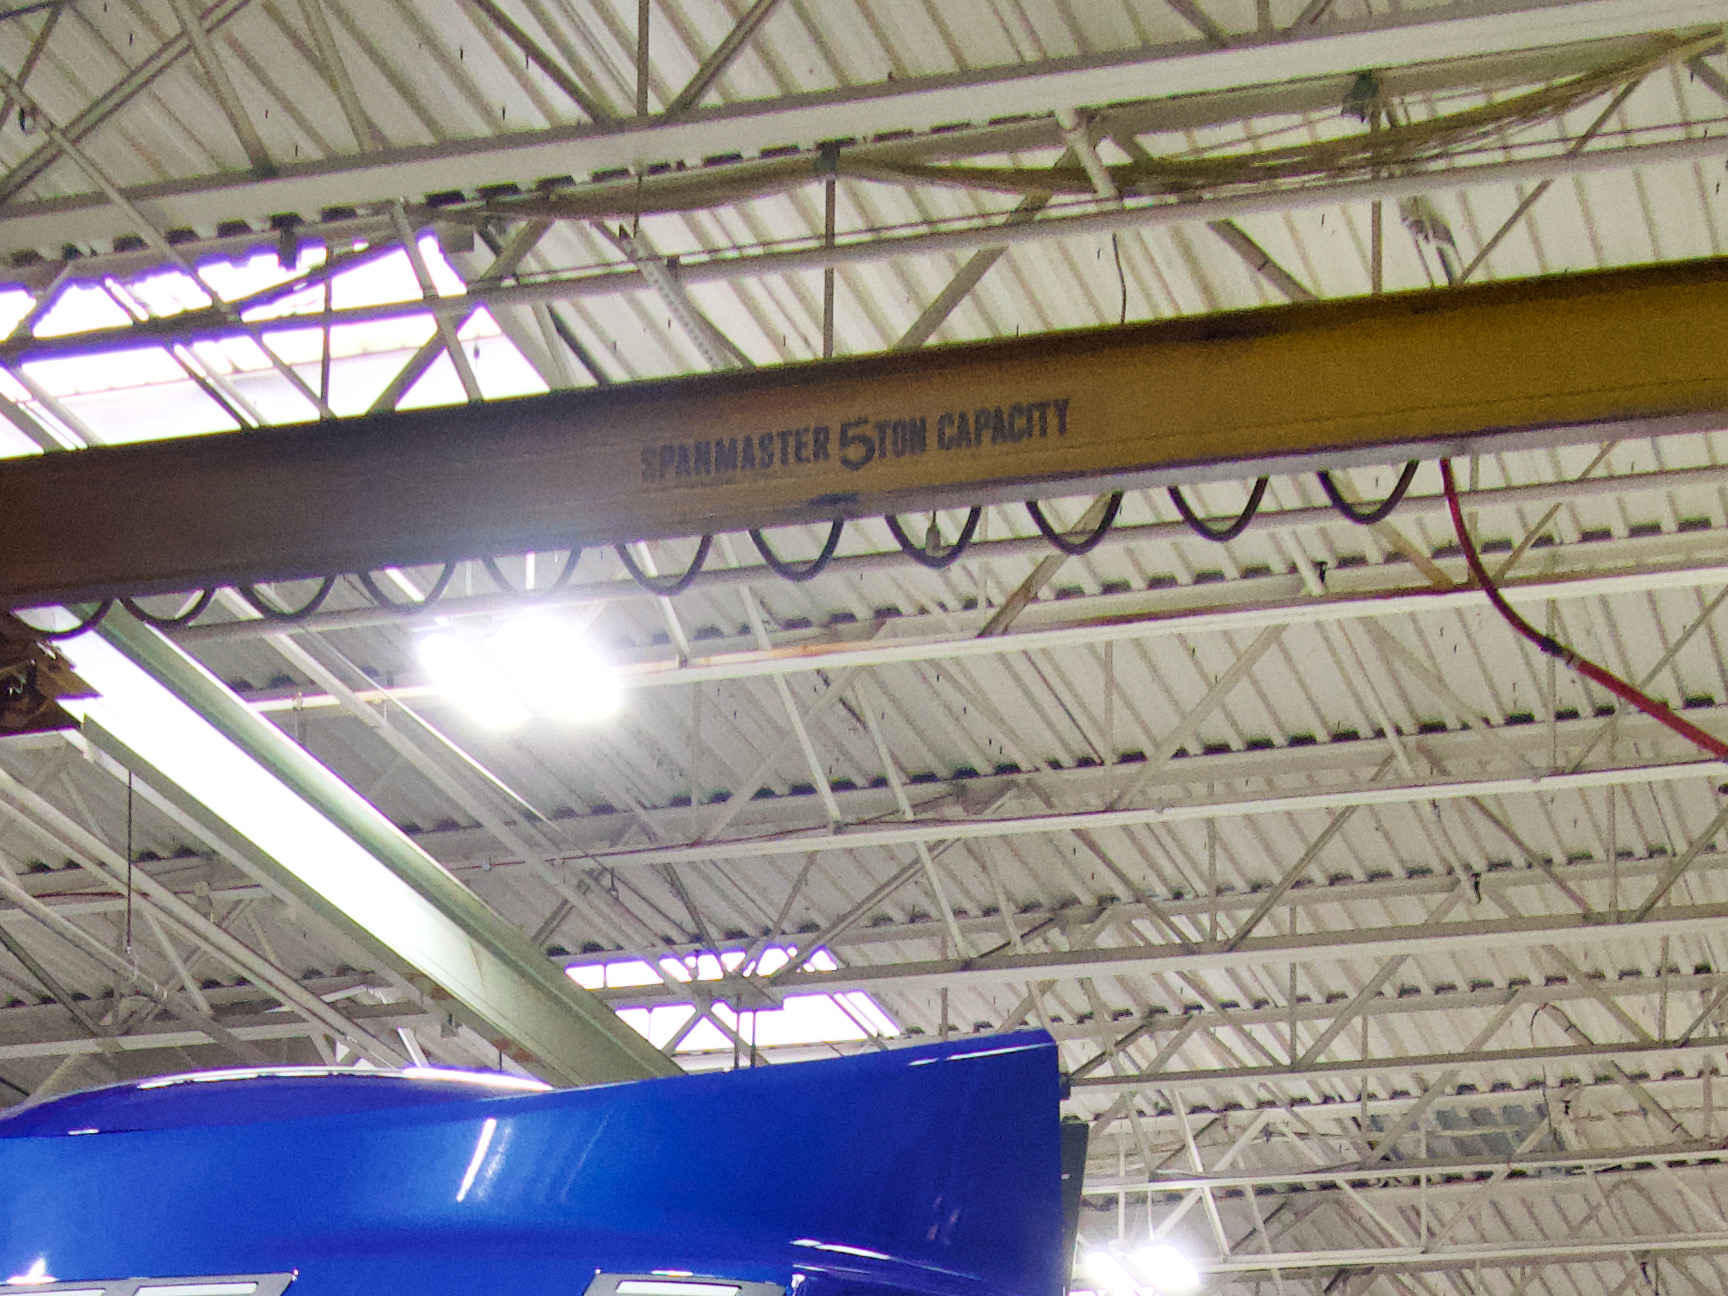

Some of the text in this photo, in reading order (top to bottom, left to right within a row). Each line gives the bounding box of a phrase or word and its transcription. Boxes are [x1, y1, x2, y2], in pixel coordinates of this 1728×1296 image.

[641, 399, 1070, 482] SPANMASTER 5 TON CAPACITY
